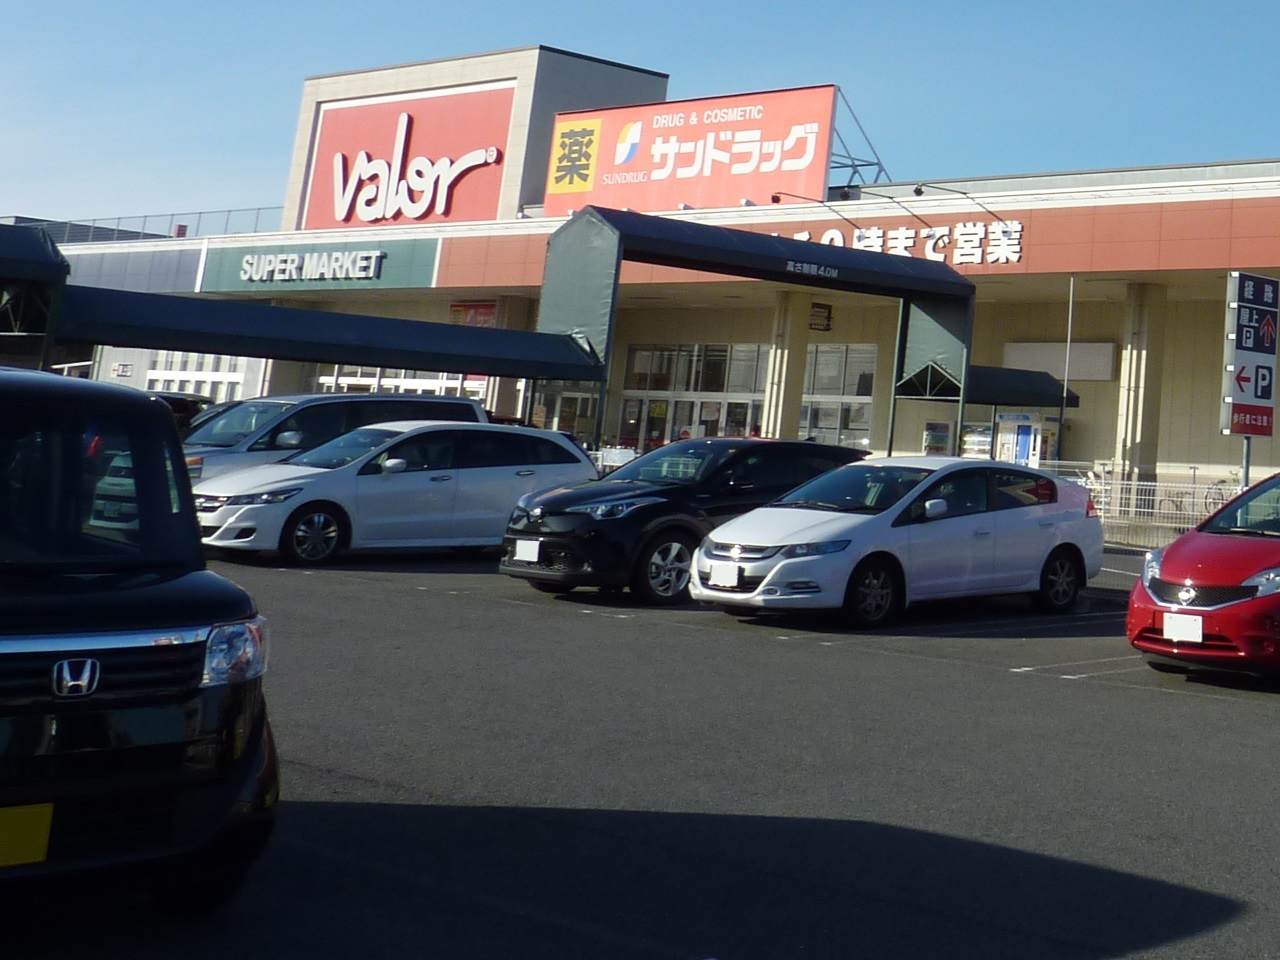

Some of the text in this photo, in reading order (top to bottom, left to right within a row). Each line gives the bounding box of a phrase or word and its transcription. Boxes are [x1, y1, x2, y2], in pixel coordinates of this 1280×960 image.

[653, 105, 764, 129] DRUG & COSMETIC
[554, 127, 595, 185] 薬
[650, 122, 819, 181] サンドラッグ
[602, 170, 648, 185] SUNDRUG
[240, 250, 382, 281] SUPER MARKET
[1243, 328, 1254, 347] P
[1256, 367, 1271, 397] P
